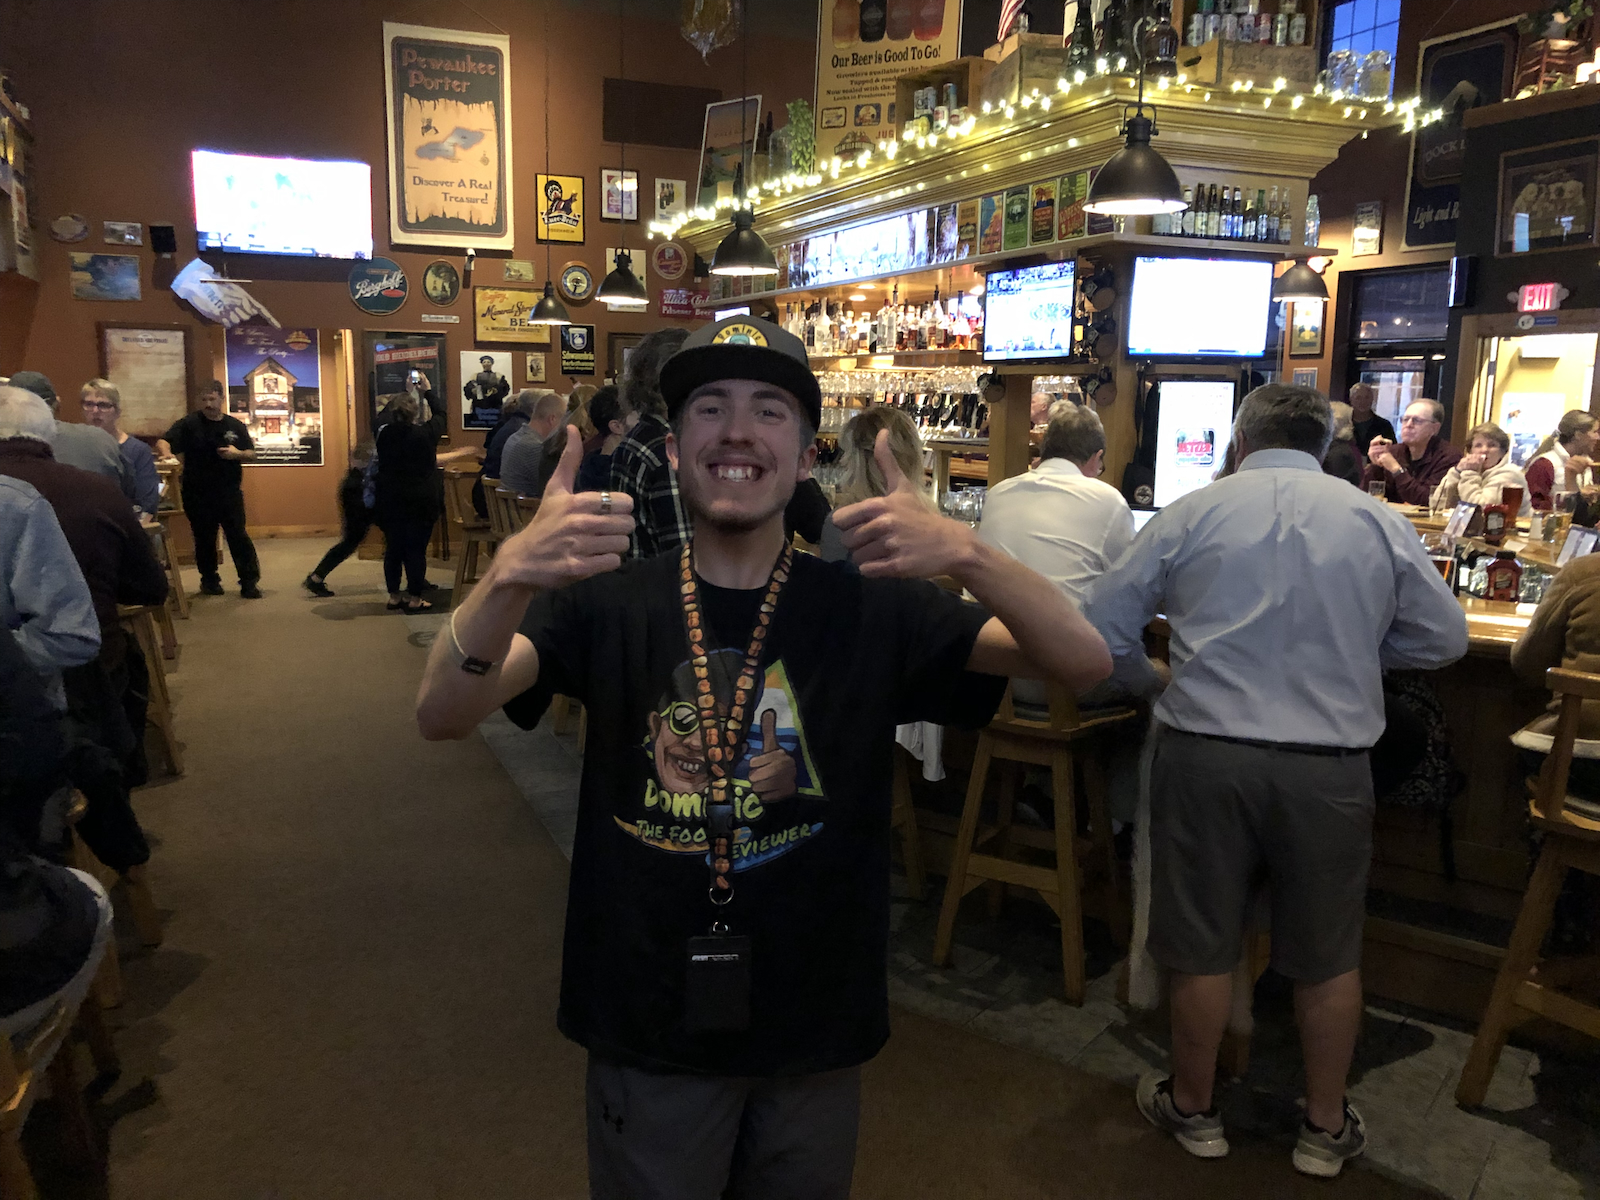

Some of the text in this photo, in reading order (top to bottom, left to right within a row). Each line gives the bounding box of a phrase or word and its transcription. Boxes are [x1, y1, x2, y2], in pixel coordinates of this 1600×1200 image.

[402, 48, 496, 76] Pewaukee
[832, 44, 941, 69] Our Beer is Good To Go!
[408, 69, 471, 93] Porter
[864, 84, 879, 92] with
[1425, 140, 1458, 162] DOCK
[412, 176, 492, 190] Discover A Real
[441, 192, 488, 205] Treasure!
[1413, 205, 1434, 229] Light
[1434, 201, 1451, 221] and
[354, 270, 405, 299] Berghoff
[1523, 283, 1554, 311] EXIT
[481, 305, 515, 321] Mineral
[717, 324, 762, 340] Dominic
[644, 778, 765, 820] Domiic
[636, 820, 812, 860] THE FOO EVIEWER
